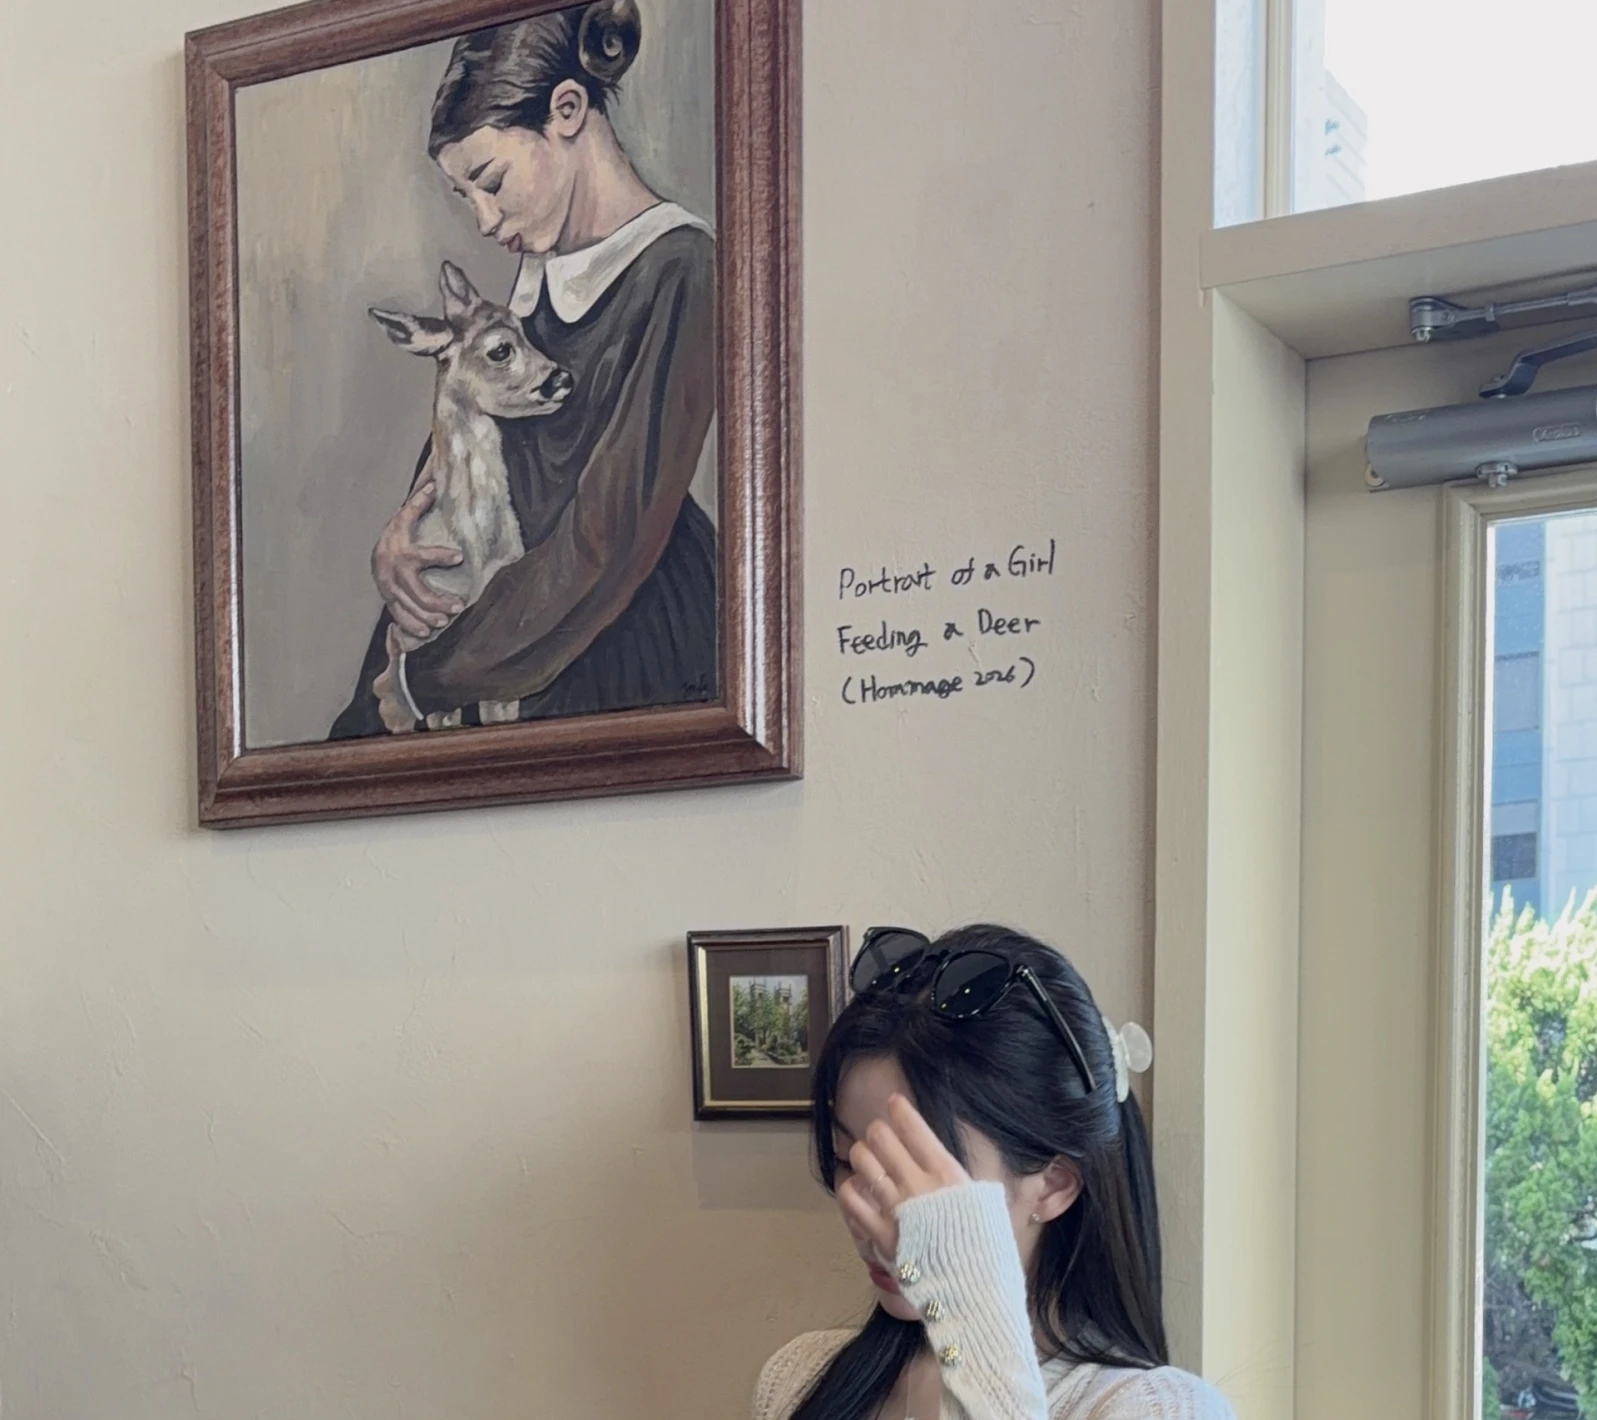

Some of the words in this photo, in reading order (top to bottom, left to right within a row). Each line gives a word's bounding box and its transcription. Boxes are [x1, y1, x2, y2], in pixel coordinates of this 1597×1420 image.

[950, 556, 975, 586] of
[983, 562, 1001, 581] a
[1007, 538, 1056, 578] Girl
[836, 620, 928, 658] Feeding
[943, 622, 964, 641] a
[977, 608, 1042, 636] Deer
[841, 674, 963, 705] (Hommage
[973, 656, 1035, 689] 2026)
